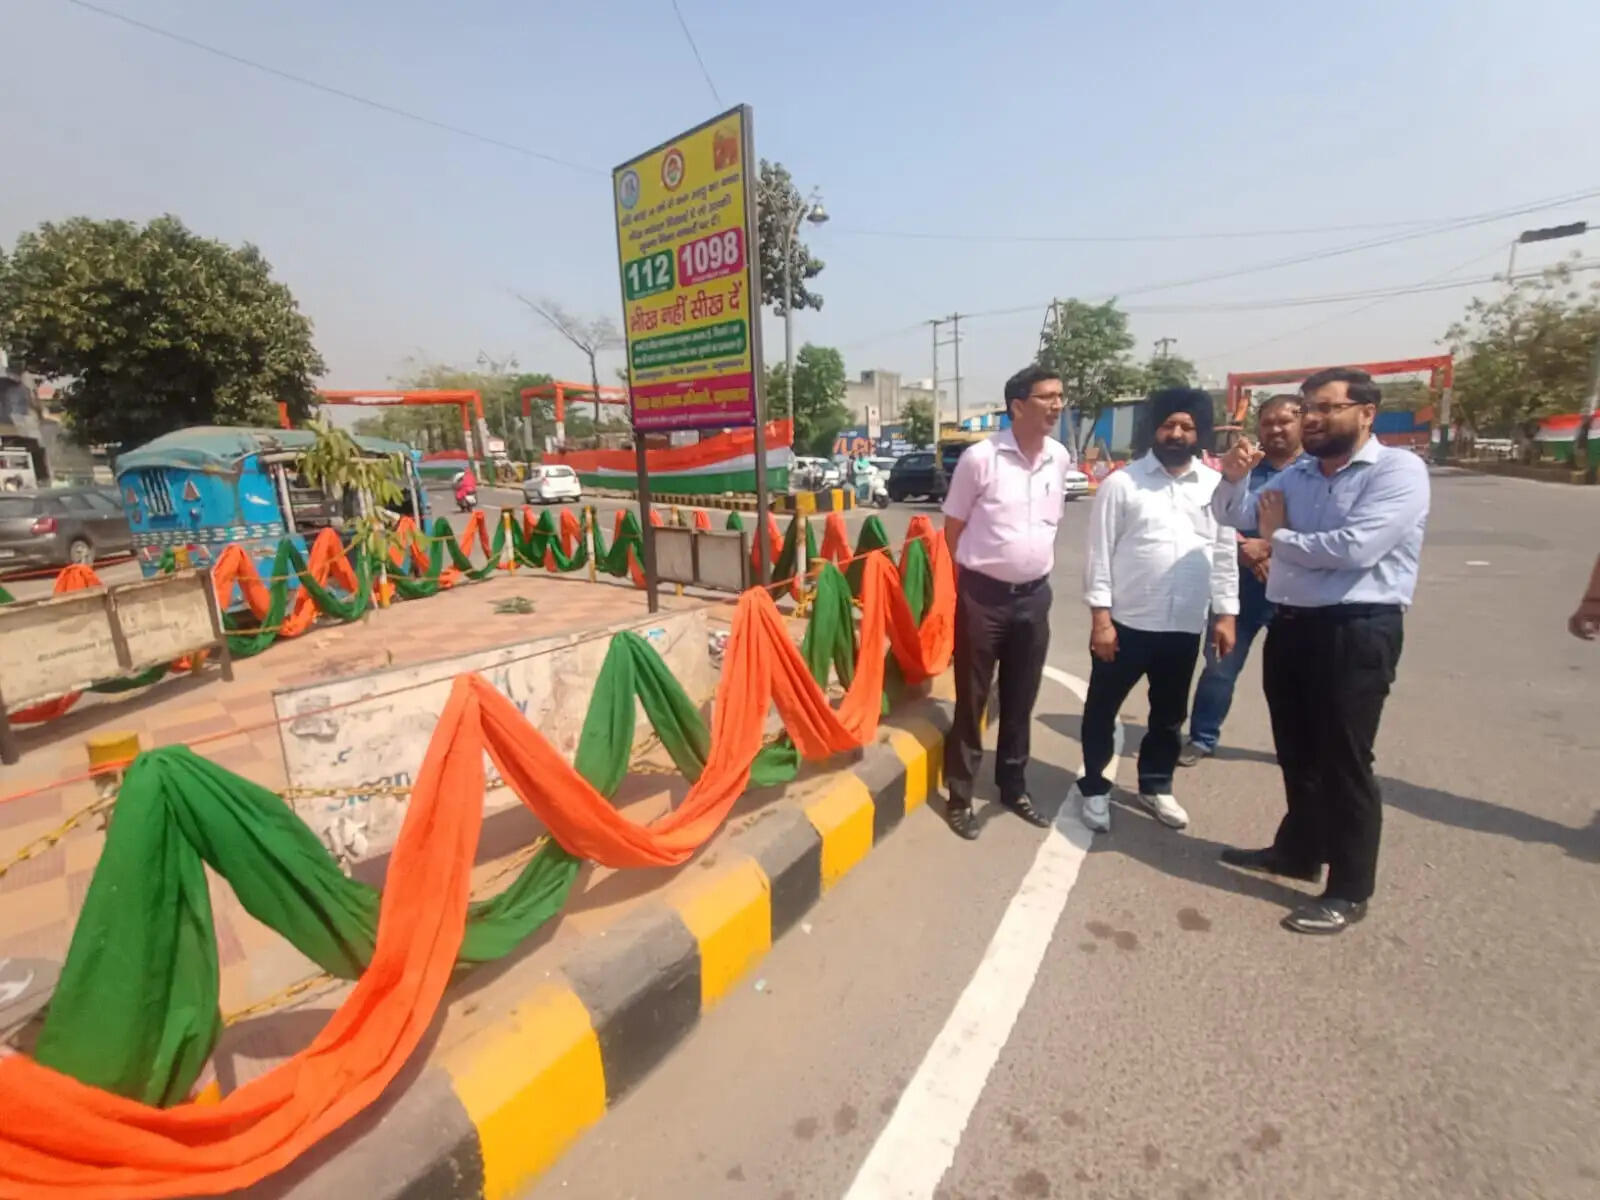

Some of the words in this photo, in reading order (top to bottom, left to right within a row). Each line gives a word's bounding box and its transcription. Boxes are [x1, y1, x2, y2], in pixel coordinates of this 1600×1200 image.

[628, 254, 671, 291] 112
[681, 231, 739, 276] 1098
[661, 295, 687, 325] नहीं
[691, 289, 723, 320] सीख
[728, 280, 742, 310] दें
